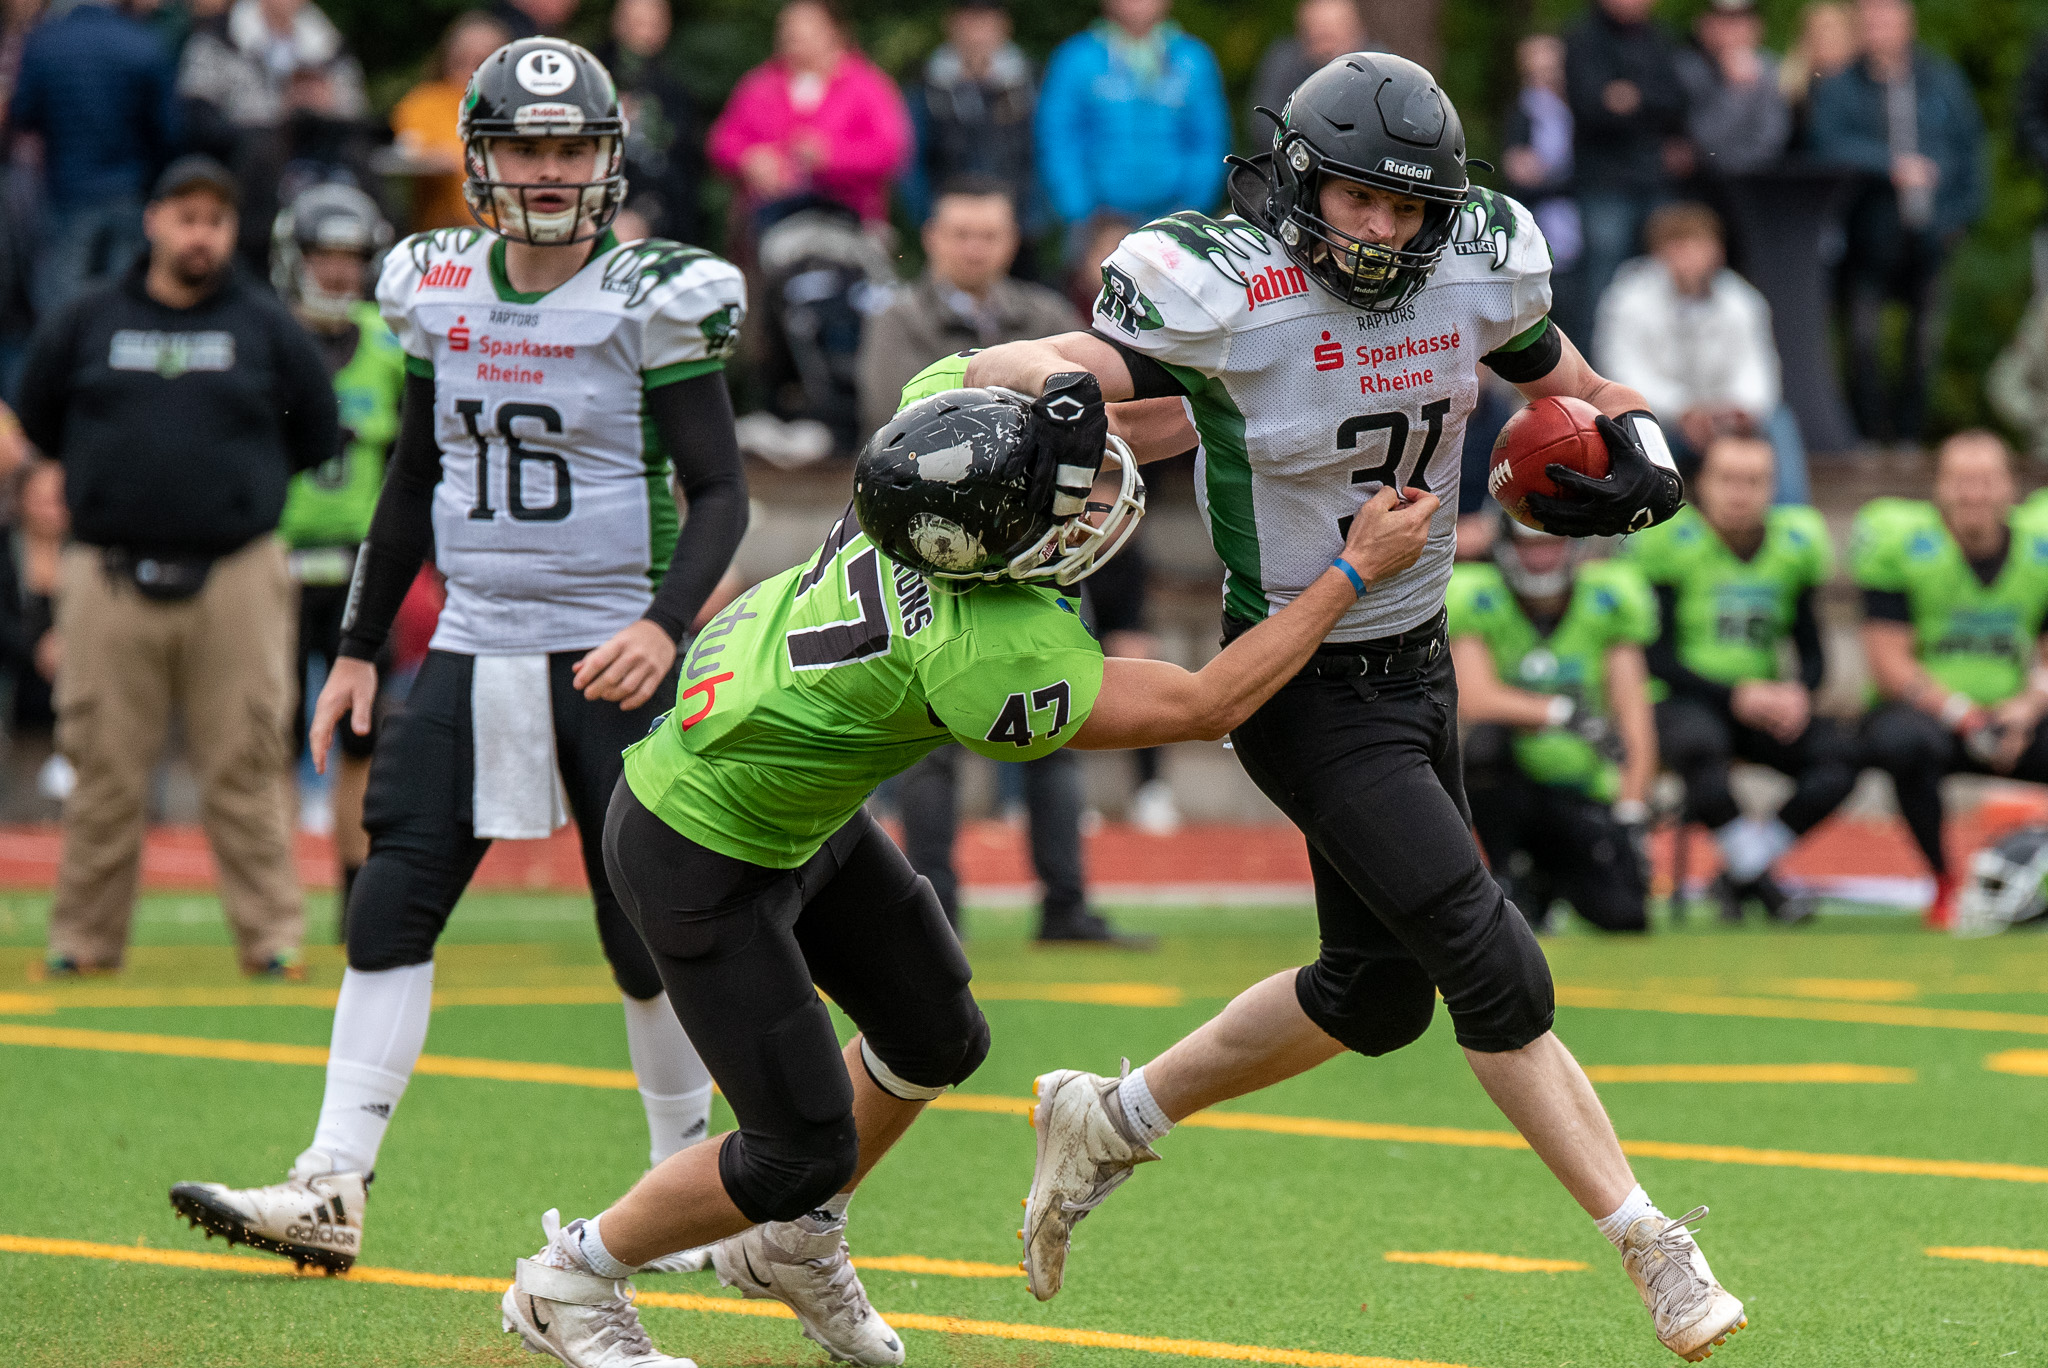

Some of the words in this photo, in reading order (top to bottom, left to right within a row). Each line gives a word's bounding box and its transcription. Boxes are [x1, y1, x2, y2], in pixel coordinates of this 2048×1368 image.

[1384, 158, 1432, 180] Riddell
[1240, 264, 1310, 312] jahn
[489, 309, 540, 328] RAPTORS
[478, 334, 576, 360] Sparkasse
[1355, 331, 1461, 369] Sparkasse
[476, 362, 544, 385] Rheine
[1359, 368, 1434, 395] Rheine
[455, 399, 573, 521] 16
[984, 678, 1071, 748] 47
